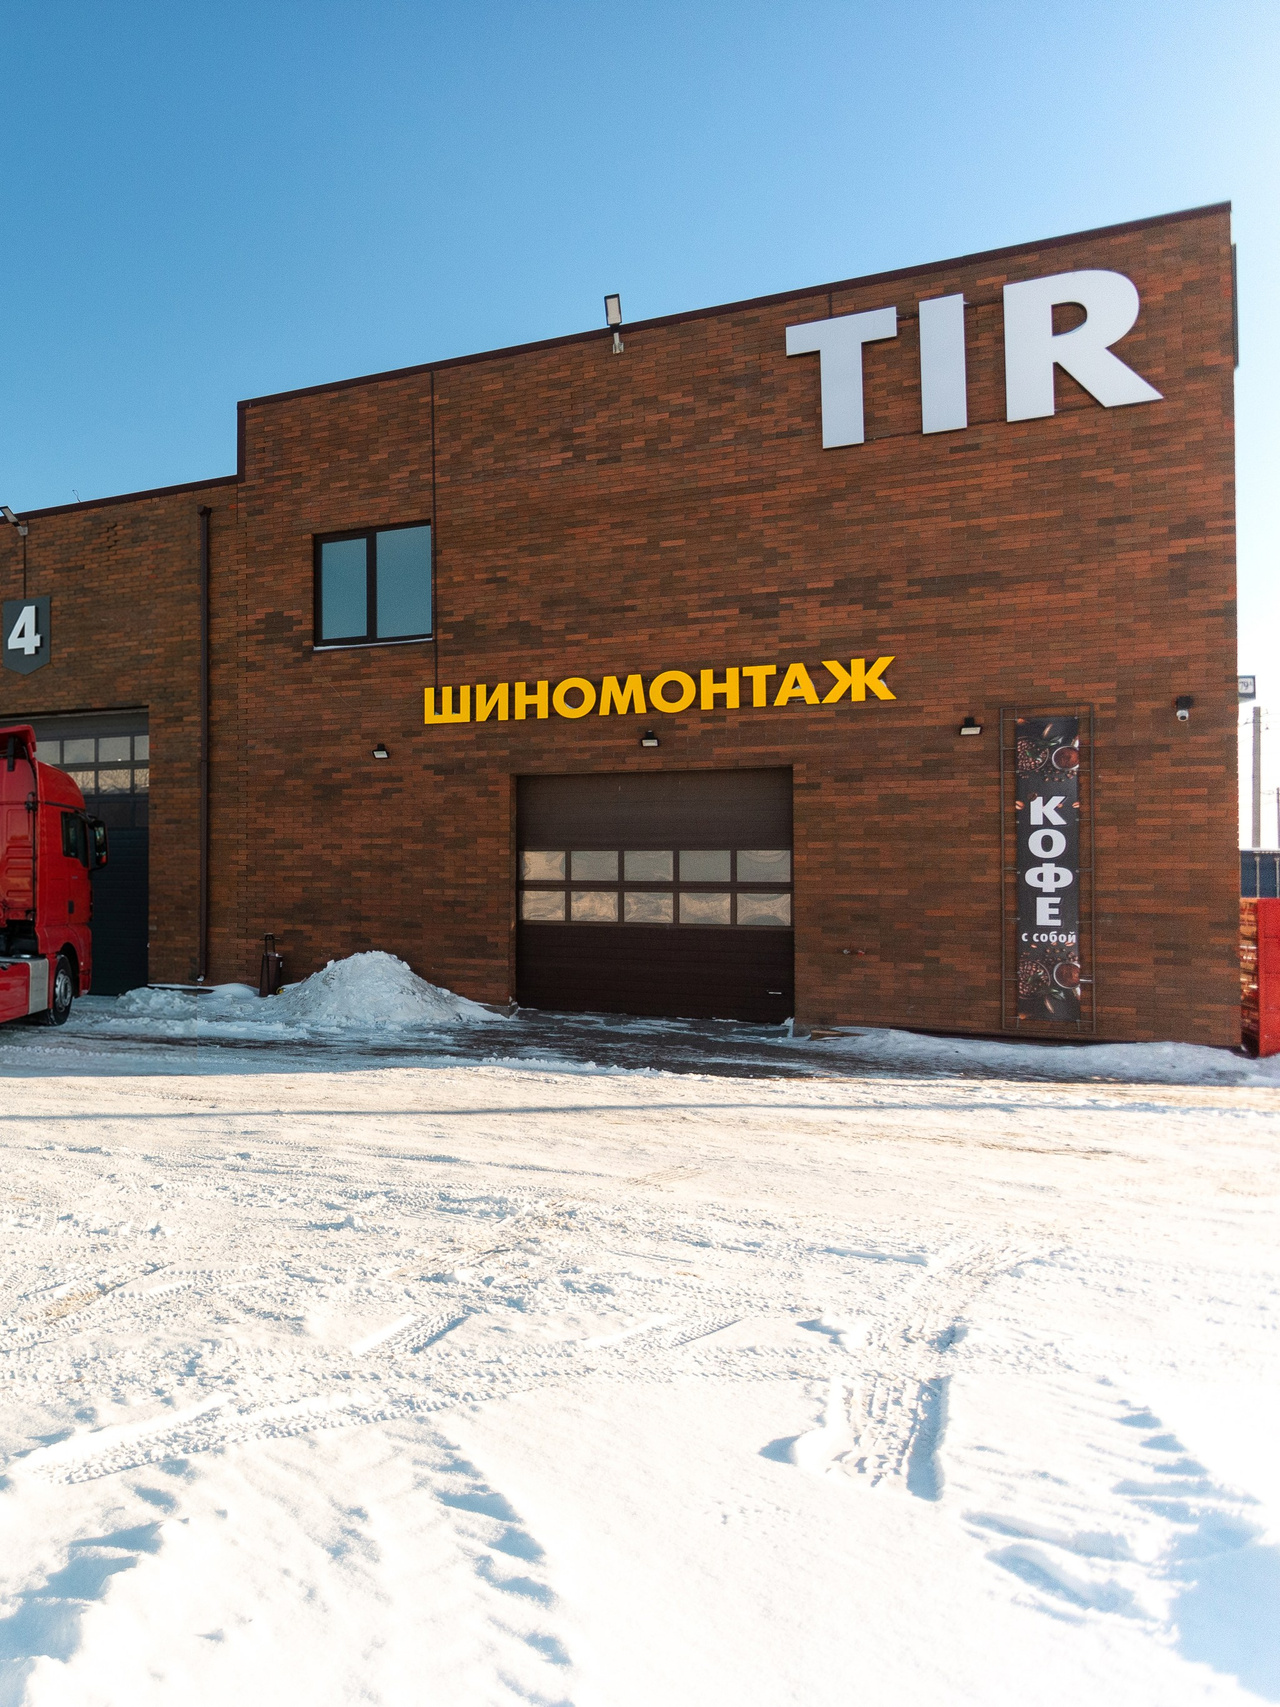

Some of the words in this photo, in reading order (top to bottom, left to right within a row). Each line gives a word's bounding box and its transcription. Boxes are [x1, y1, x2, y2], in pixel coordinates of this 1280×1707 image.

[785, 269, 1164, 449] TIR
[8, 605, 41, 655] 4
[423, 656, 898, 725] ШИНОМОНТАЖ
[1025, 795, 1073, 927] КОФЕ
[1021, 932, 1029, 942] с
[1032, 931, 1076, 943] собой
